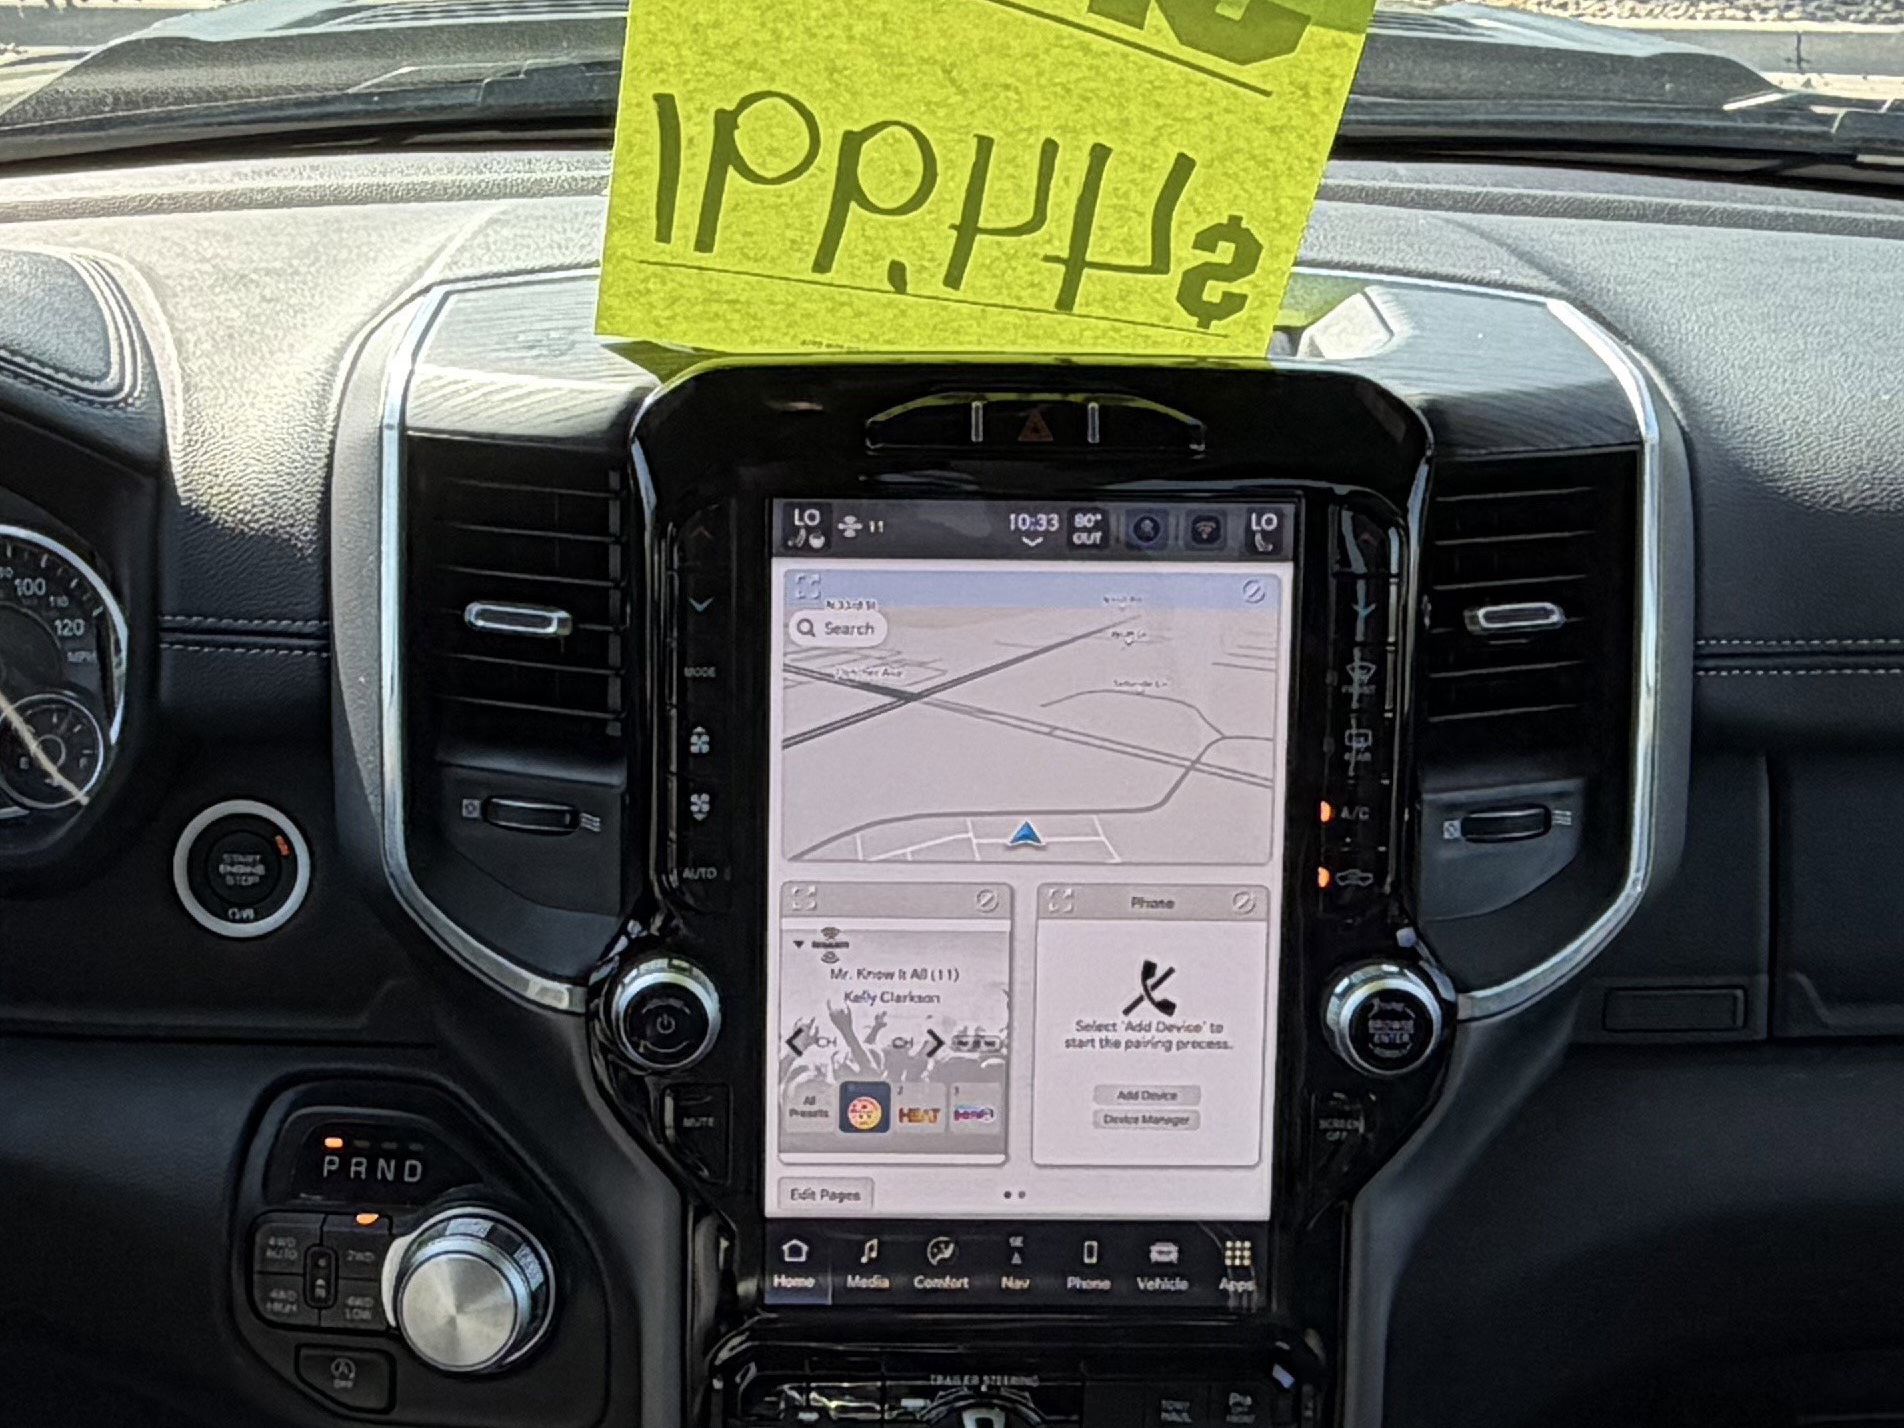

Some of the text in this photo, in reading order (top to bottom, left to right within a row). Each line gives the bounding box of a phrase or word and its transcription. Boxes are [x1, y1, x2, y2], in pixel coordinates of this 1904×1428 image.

[794, 509, 820, 526] LO
[1008, 514, 1060, 531] 10:33
[1251, 513, 1277, 531] LO
[1073, 532, 1102, 546] OUT
[15, 579, 46, 596] 100
[55, 619, 85, 637] 120
[825, 621, 875, 636] Search
[684, 666, 716, 678] MODE
[1341, 806, 1370, 820] A/C
[225, 874, 260, 885] STOP
[683, 868, 718, 880] AUTO
[1130, 896, 1175, 911] Phone
[831, 968, 853, 981] Mr.
[856, 967, 895, 981] Know
[844, 990, 941, 1006] Kelly Clarkson
[1076, 1019, 1117, 1034] Select
[1210, 1021, 1223, 1034] to
[1064, 1037, 1233, 1053] start the pairing process.
[1116, 1089, 1177, 1102] Add Device
[789, 1108, 829, 1119] Presets
[1103, 1113, 1190, 1129] Device Manager
[682, 1115, 715, 1128] MUTE
[323, 1155, 422, 1182] P R N D
[791, 1188, 861, 1205] Edit Pages
[773, 1275, 815, 1289] Home
[847, 1275, 890, 1290] Media
[913, 1275, 969, 1290] Comfort
[1001, 1276, 1030, 1290] Nav
[1067, 1276, 1112, 1291] Phone
[1137, 1276, 1189, 1291] Vehicle
[1218, 1276, 1256, 1294] Apps
